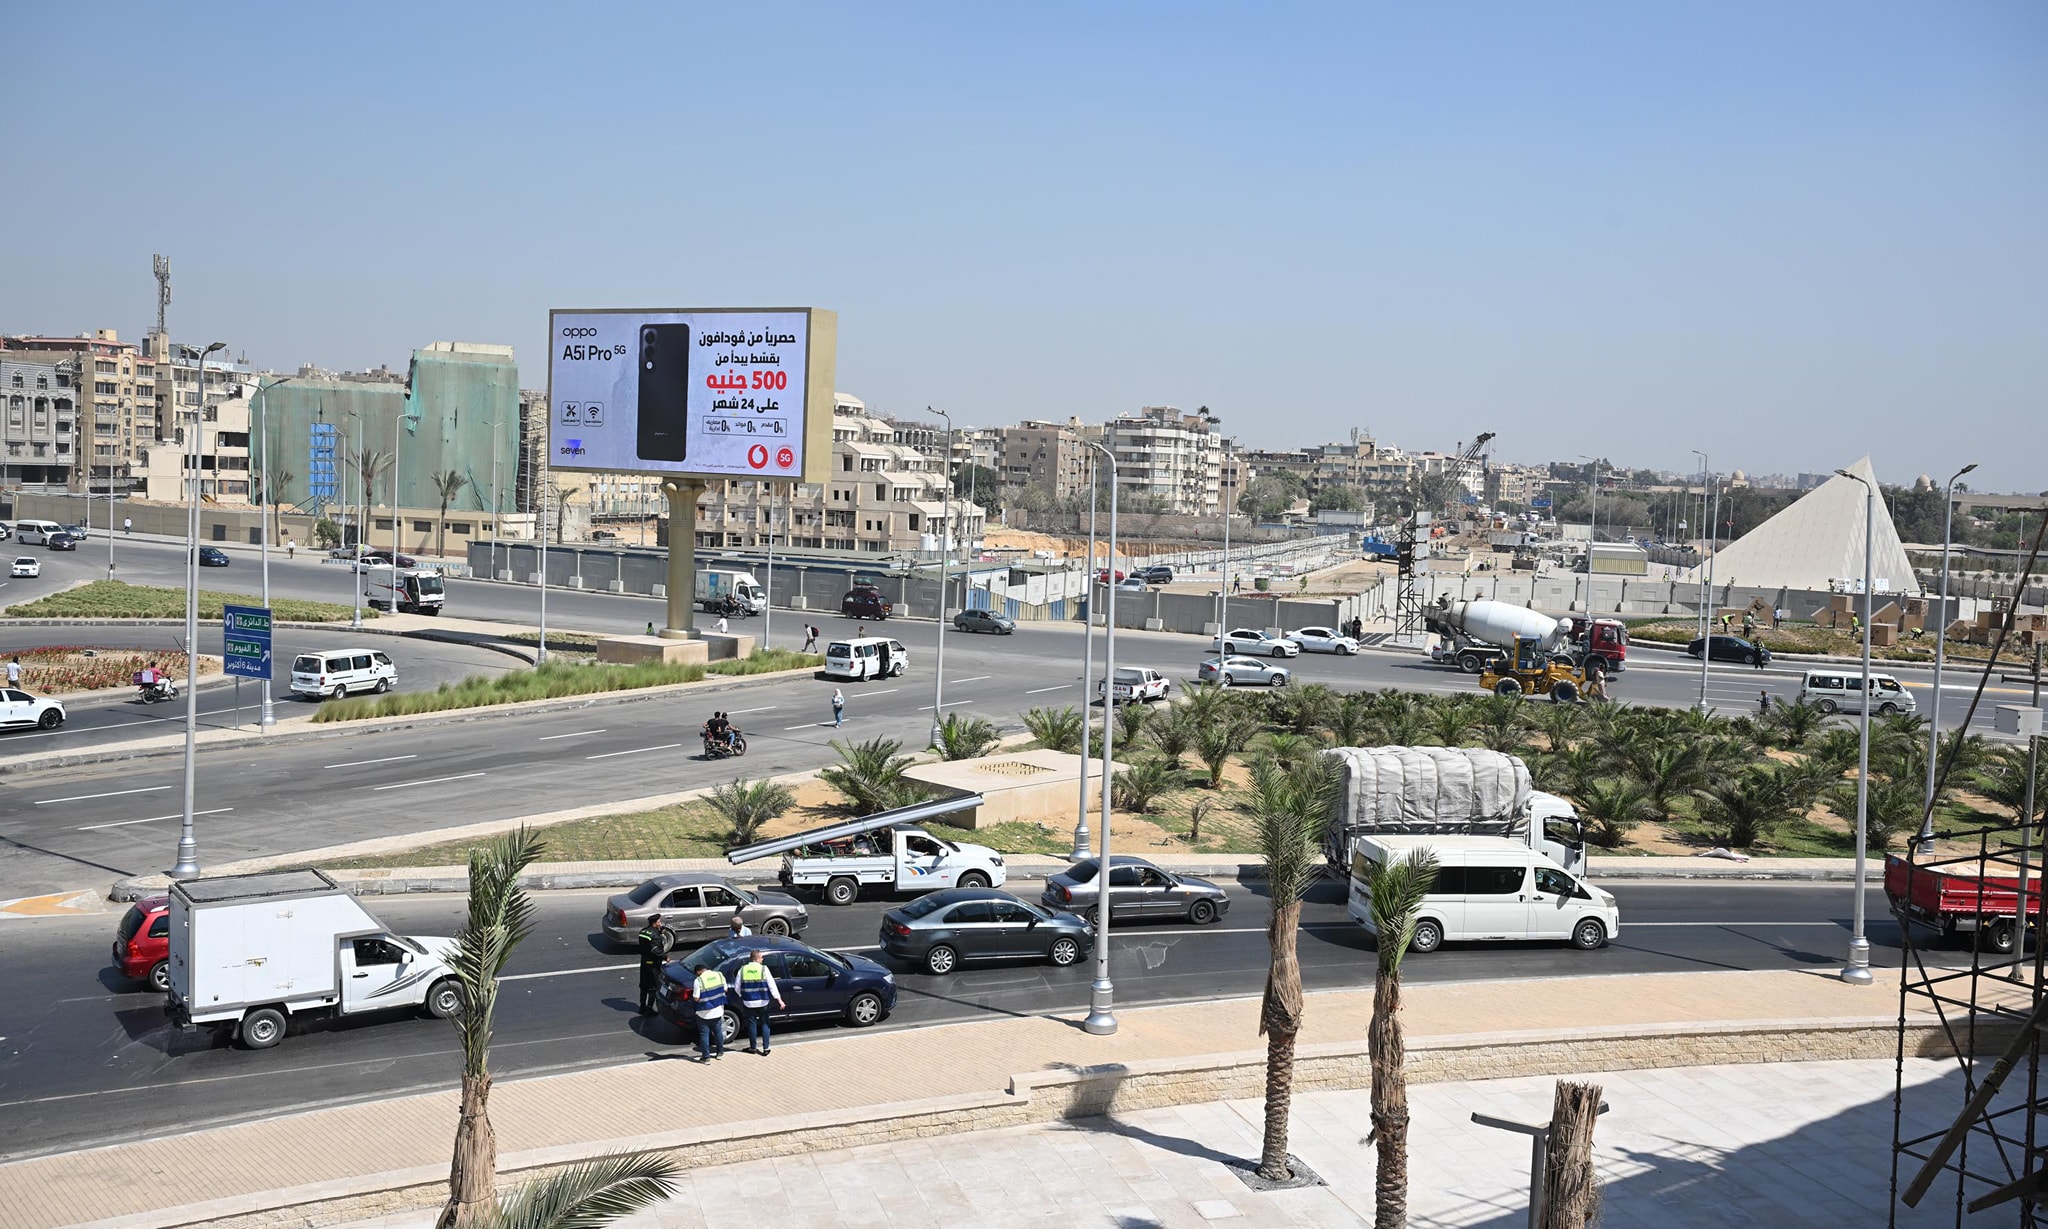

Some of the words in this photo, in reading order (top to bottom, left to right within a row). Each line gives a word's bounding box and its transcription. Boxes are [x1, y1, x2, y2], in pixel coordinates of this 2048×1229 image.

[562, 327, 597, 339] oppo
[747, 331, 763, 346] من
[562, 345, 585, 360] A5i
[588, 345, 612, 360] Pro
[614, 345, 626, 354] 5G
[715, 352, 730, 366] من
[731, 350, 748, 366] يبدأ
[706, 369, 748, 395] جنيه
[751, 370, 787, 390] 500
[711, 396, 739, 412] شهر
[741, 398, 755, 410] 24
[560, 446, 585, 455] seven
[780, 453, 791, 462] 5G
[234, 644, 251, 653] الفيوم
[241, 661, 246, 670] 6
[246, 661, 261, 672] مدينة
